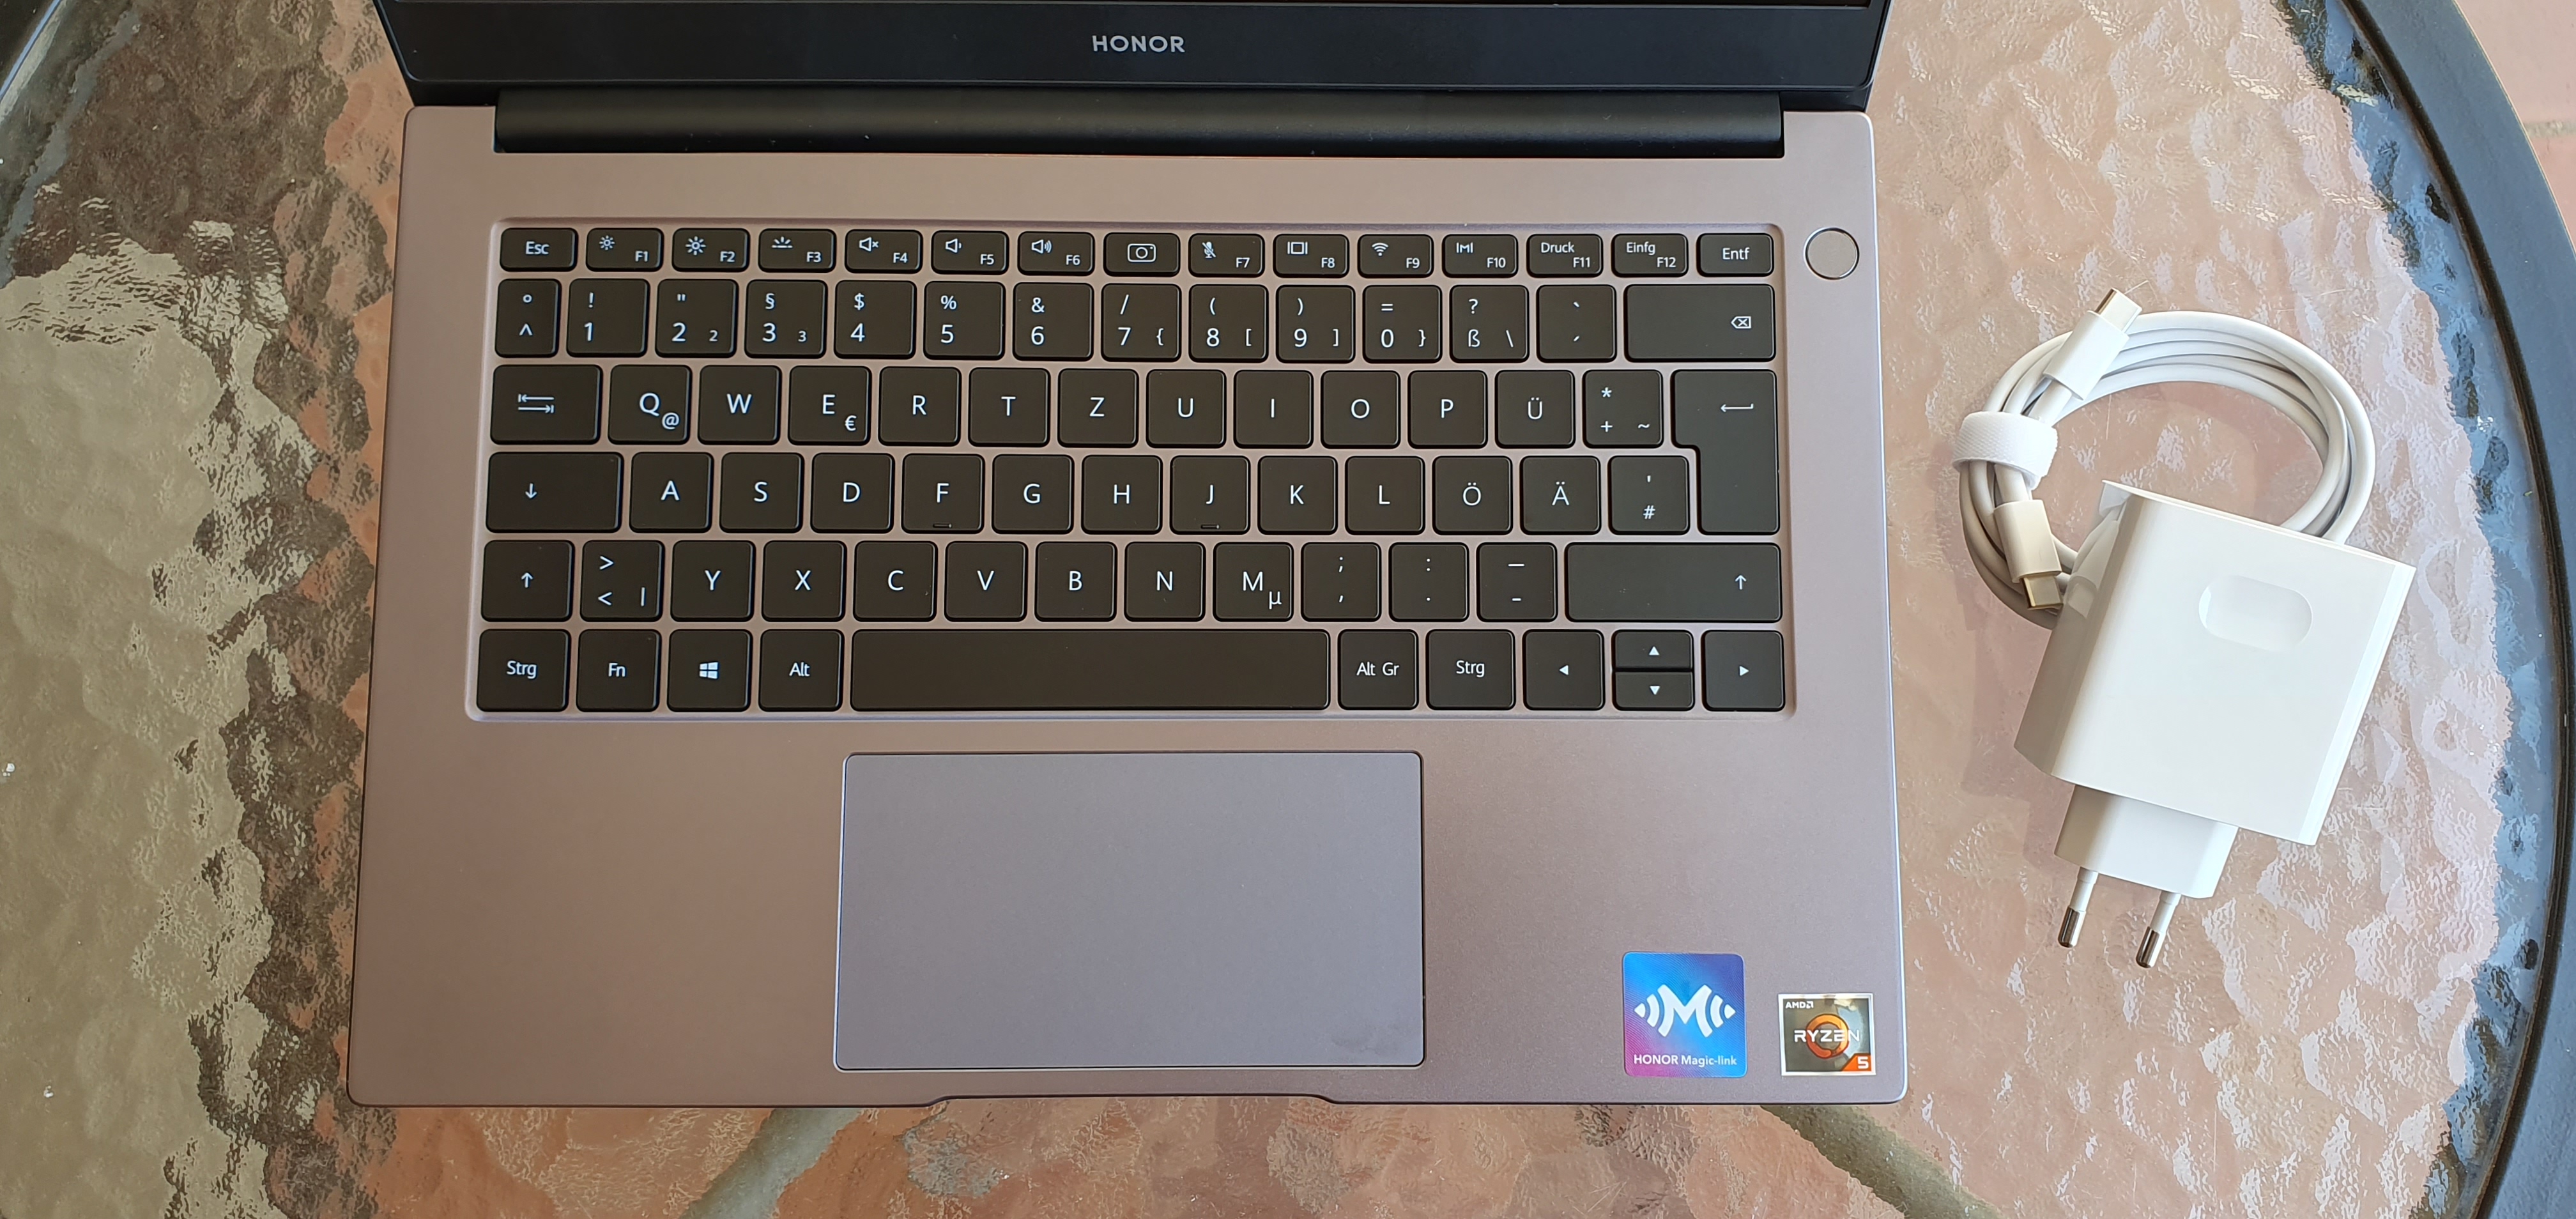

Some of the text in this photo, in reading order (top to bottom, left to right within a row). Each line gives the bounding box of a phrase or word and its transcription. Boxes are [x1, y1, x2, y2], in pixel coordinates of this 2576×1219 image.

[1091, 34, 1186, 53] HONOR
[525, 240, 550, 256] Esc
[634, 250, 649, 263] F1
[719, 250, 736, 263] F2
[806, 250, 822, 263] F3
[1540, 240, 1575, 254] Druck
[1625, 240, 1657, 256] Einfg
[1722, 246, 1751, 261] Entf
[892, 251, 908, 264] F4
[979, 253, 995, 266] F5
[1065, 254, 1081, 266] F6
[1235, 256, 1251, 269] F7
[1321, 256, 1336, 269] F8
[1405, 256, 1421, 270] F9
[1486, 256, 1507, 269] F10
[1572, 256, 1591, 269] F11
[1656, 256, 1677, 268] F12
[588, 291, 594, 309] !
[764, 292, 776, 310] §
[853, 292, 865, 311] $
[940, 294, 958, 310] %
[1031, 296, 1045, 314] &
[1119, 293, 1130, 316] /
[1209, 296, 1216, 316] (
[1297, 297, 1304, 316] )
[1380, 303, 1394, 312] =
[1468, 298, 1479, 315] ?
[583, 321, 594, 342] 1
[671, 321, 687, 342] 2
[708, 329, 719, 342] 2
[762, 321, 777, 343] 3
[797, 330, 807, 343] 3
[849, 322, 866, 343] 4
[940, 323, 954, 344] 5
[1030, 325, 1045, 346] 6
[1117, 326, 1132, 346] 7
[1155, 327, 1165, 347] {
[1206, 326, 1220, 348] 8
[1245, 328, 1253, 348] [
[1293, 327, 1308, 348] 9
[1331, 328, 1340, 348] ]
[1380, 328, 1395, 349] 0
[1417, 328, 1427, 348] }
[1467, 328, 1481, 348] ß
[638, 392, 661, 417] Q
[726, 392, 753, 415] W
[822, 393, 836, 415] E
[912, 394, 927, 416] R
[1000, 395, 1017, 417] T
[1089, 396, 1105, 418] Z
[1177, 397, 1194, 418] U
[1270, 397, 1276, 419] I
[1350, 397, 1371, 420] O
[1440, 398, 1455, 419] P
[1527, 396, 1544, 420] Ü
[661, 411, 680, 431] @
[844, 414, 857, 432] €
[1599, 420, 1614, 433] +
[660, 479, 680, 502] A
[753, 480, 768, 503] S
[842, 481, 861, 503] D
[936, 482, 950, 504] F
[1022, 482, 1041, 505] G
[1113, 483, 1131, 505] H
[1205, 484, 1215, 505] J
[1289, 484, 1305, 505] K
[1378, 484, 1392, 505] L
[1462, 481, 1482, 507] Ö
[1551, 480, 1570, 507] Ä
[1642, 504, 1657, 520] #
[599, 555, 615, 571] >
[704, 569, 721, 592] Y
[793, 569, 811, 591] X
[887, 569, 905, 592] C
[976, 569, 995, 592] V
[1068, 570, 1083, 592] B
[1156, 570, 1174, 592] N
[1242, 571, 1264, 592] M
[597, 591, 613, 606] <
[505, 659, 537, 680] Strg
[608, 662, 626, 678] Fn
[788, 661, 811, 677] Alt
[1355, 661, 1400, 677] Alt Gr
[1455, 659, 1485, 678] Strg
[1794, 1029, 1860, 1043] RYZEN
[1634, 1054, 1737, 1068] HONOR Magic-link
[1857, 1056, 1869, 1070] 5
